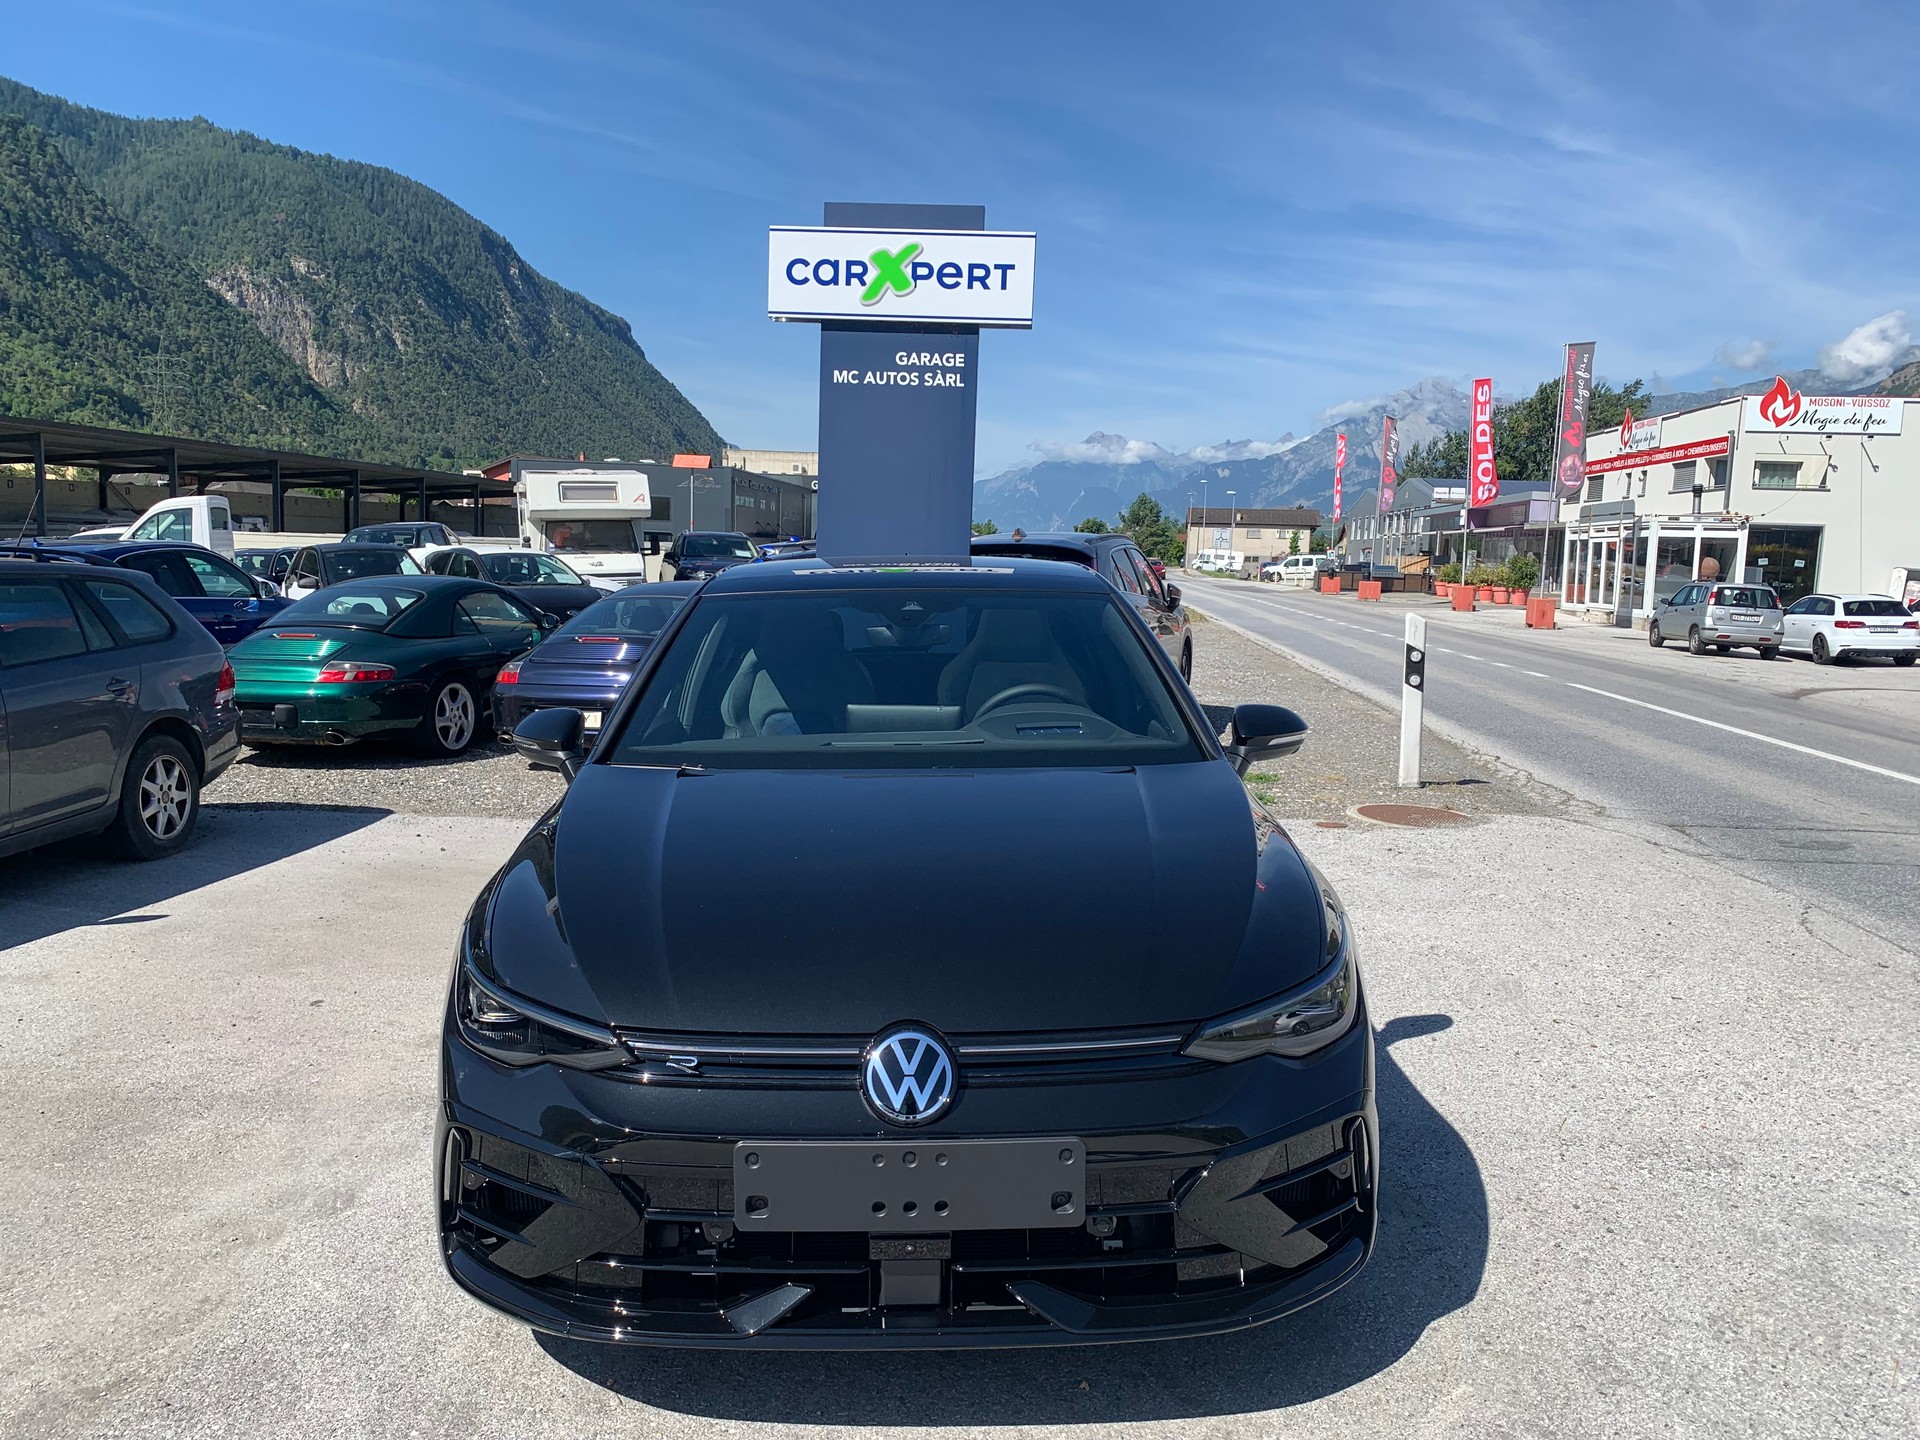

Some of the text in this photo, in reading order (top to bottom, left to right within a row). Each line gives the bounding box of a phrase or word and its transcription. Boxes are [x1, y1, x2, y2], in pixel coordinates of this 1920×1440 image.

[895, 352, 965, 367] GARAGE
[833, 369, 965, 387] MC AUTOS SÀRL
[1808, 397, 1891, 408] MOSONI-VUISSOZ
[1789, 409, 1888, 432] Magie du feu
[1476, 384, 1497, 500] SOLDES
